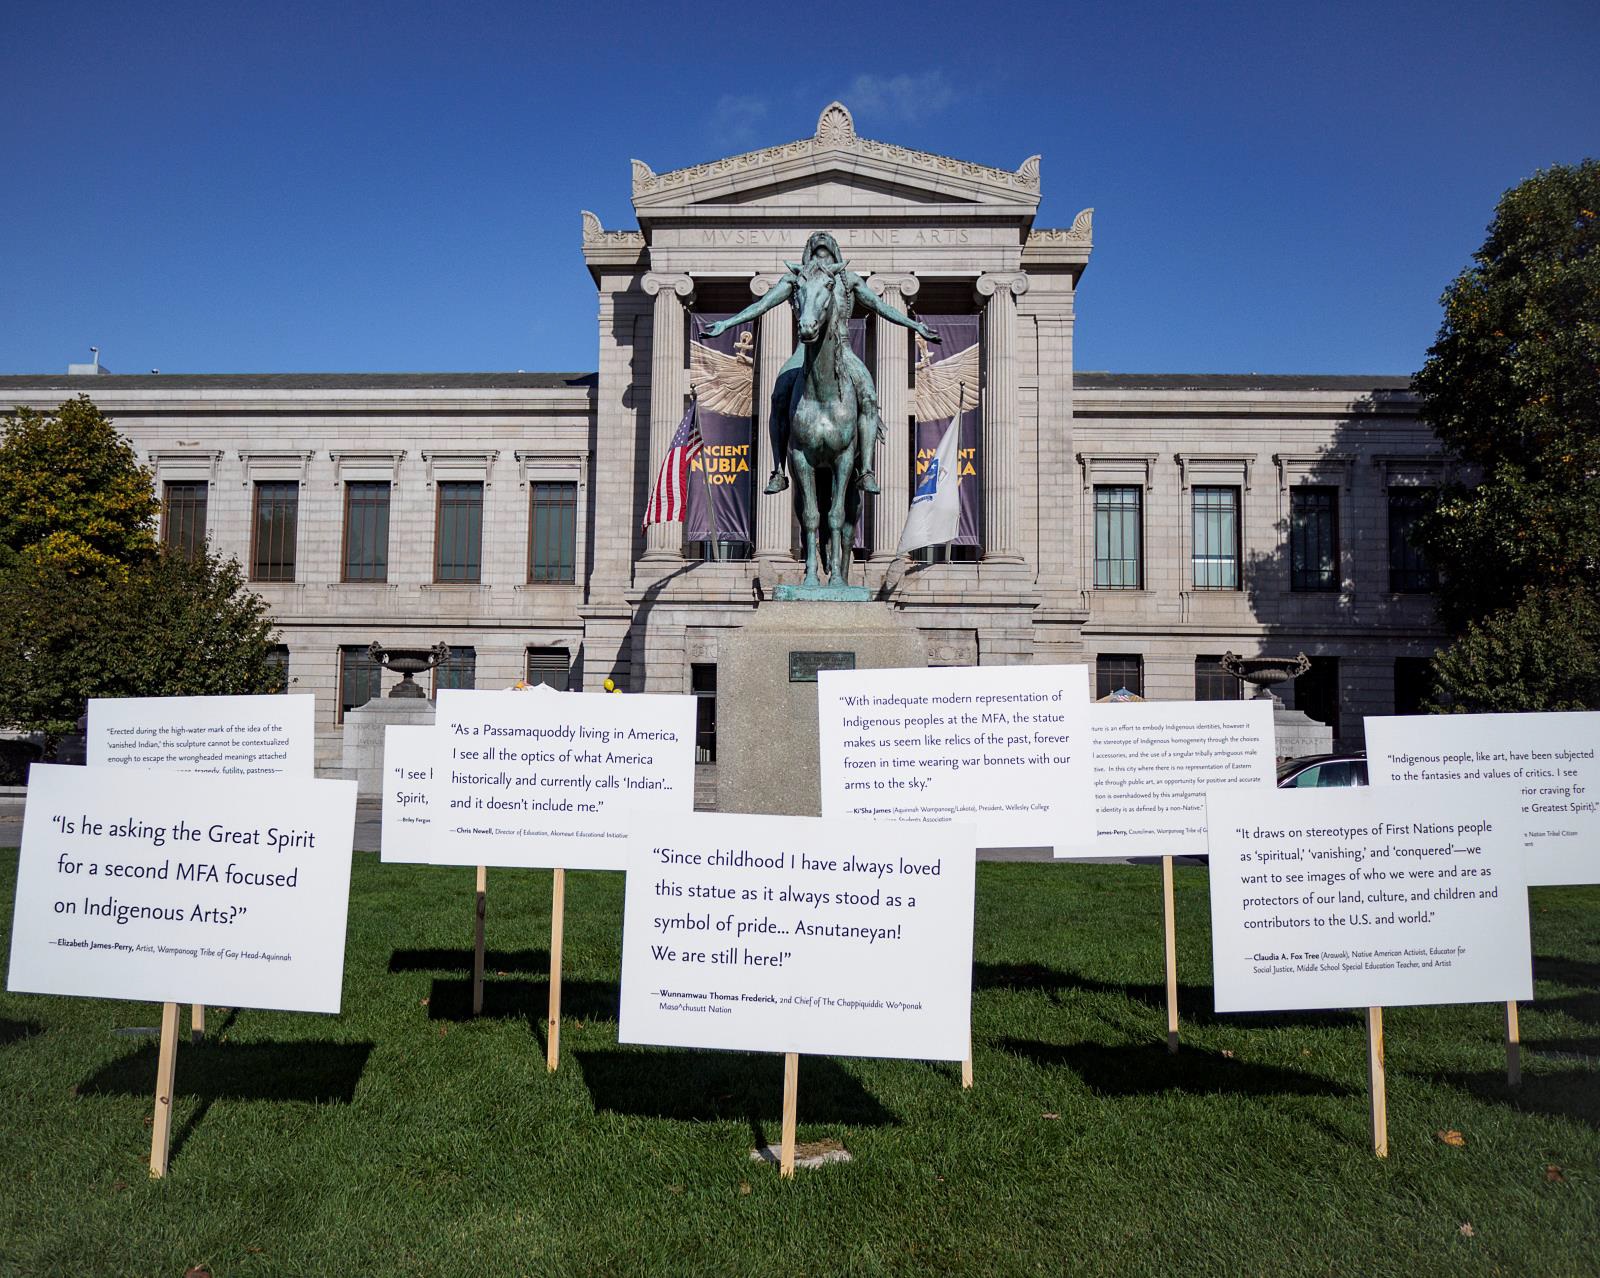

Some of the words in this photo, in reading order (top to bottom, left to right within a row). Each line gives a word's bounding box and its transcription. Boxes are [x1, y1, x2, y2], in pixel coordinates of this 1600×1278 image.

[850, 230, 900, 244] FINE
[914, 229, 970, 244] ARTS
[697, 445, 750, 456] NCIENT
[691, 458, 750, 472] NUBIA
[840, 695, 869, 706] “With
[873, 694, 928, 709] inadequate
[932, 692, 971, 704] modern
[976, 692, 1048, 706] representation
[1052, 690, 1063, 701] of
[135, 726, 158, 736] during
[158, 726, 169, 734] the
[170, 726, 206, 736] high-water
[207, 725, 224, 733] mark
[225, 724, 234, 732] of
[247, 724, 261, 733] idea
[262, 724, 271, 732] of
[843, 716, 900, 730] Indigenous
[904, 714, 944, 729] peoples
[947, 716, 957, 724] at
[961, 713, 978, 724] the
[981, 713, 1009, 725] MFA,
[1012, 712, 1029, 723] the
[1032, 714, 1064, 722] statue
[451, 723, 469, 735] “As
[484, 724, 576, 742] Passamaquoddy
[580, 725, 610, 743] living
[614, 728, 624, 739] in
[627, 728, 678, 742] America,
[453, 748, 456, 759] I
[482, 747, 495, 760] all
[498, 748, 517, 760] the
[521, 750, 555, 766] optics
[558, 749, 572, 762] of
[574, 750, 602, 763] what
[605, 752, 652, 764] America
[1388, 753, 1440, 766] “Indigenous
[1443, 752, 1474, 765] people,
[1476, 752, 1490, 761] like
[1493, 753, 1507, 762] art,
[1509, 750, 1529, 760] have
[1531, 750, 1552, 760] been
[1554, 749, 1594, 762] subjected
[395, 768, 403, 779] “I
[452, 770, 512, 790] historically
[515, 773, 536, 786] and
[540, 774, 591, 792] currently
[595, 775, 620, 788] calls
[396, 792, 428, 807] Spirit,
[450, 796, 471, 808] and
[476, 798, 483, 808] it
[532, 798, 573, 812] include
[577, 801, 603, 812] me.”
[52, 816, 75, 834] “Is
[82, 815, 102, 835] he
[108, 817, 166, 846] asking
[172, 820, 201, 841] the
[208, 825, 260, 845] Great
[266, 828, 315, 853] Spirit
[1236, 829, 1250, 839] “It
[1253, 827, 1285, 839] draws
[1288, 830, 1302, 838] on
[1306, 827, 1368, 840] stereotypes
[1371, 823, 1384, 835] of
[1386, 824, 1409, 835] First
[1413, 823, 1454, 834] Nations
[1457, 820, 1492, 836] people
[653, 848, 701, 865] “Since
[707, 849, 784, 868] childhood
[792, 854, 794, 869] I
[802, 853, 836, 871] have
[842, 855, 893, 879] always
[900, 857, 940, 876] loved
[1254, 848, 1304, 865] ‘spiritual,’
[1308, 846, 1366, 862] ‘vanishing,’
[1370, 845, 1390, 858] and
[57, 853, 83, 874] for
[89, 864, 98, 875] a
[104, 860, 168, 879] second
[176, 863, 218, 882] MFA
[225, 863, 297, 887] focused
[654, 879, 682, 896] this
[688, 885, 736, 899] statue
[742, 890, 757, 900] as
[764, 886, 773, 901] it
[779, 885, 829, 909] always
[836, 889, 879, 906] stood
[886, 896, 901, 906] as
[908, 897, 915, 907] a
[54, 902, 76, 914] on
[84, 896, 184, 925] Indigenous
[190, 904, 246, 924] Arts?”
[654, 913, 710, 934] symbol
[716, 915, 734, 931] of
[737, 916, 789, 938] pride...
[795, 920, 900, 944] Asnutaneyan!
[216, 949, 223, 959] of
[651, 945, 676, 961] We
[682, 952, 705, 962] are
[711, 948, 737, 964] still
[744, 948, 791, 967] here!”
[709, 992, 739, 1001] Thomas
[741, 994, 777, 1004] Frederick,
[708, 1005, 732, 1014] Nation
